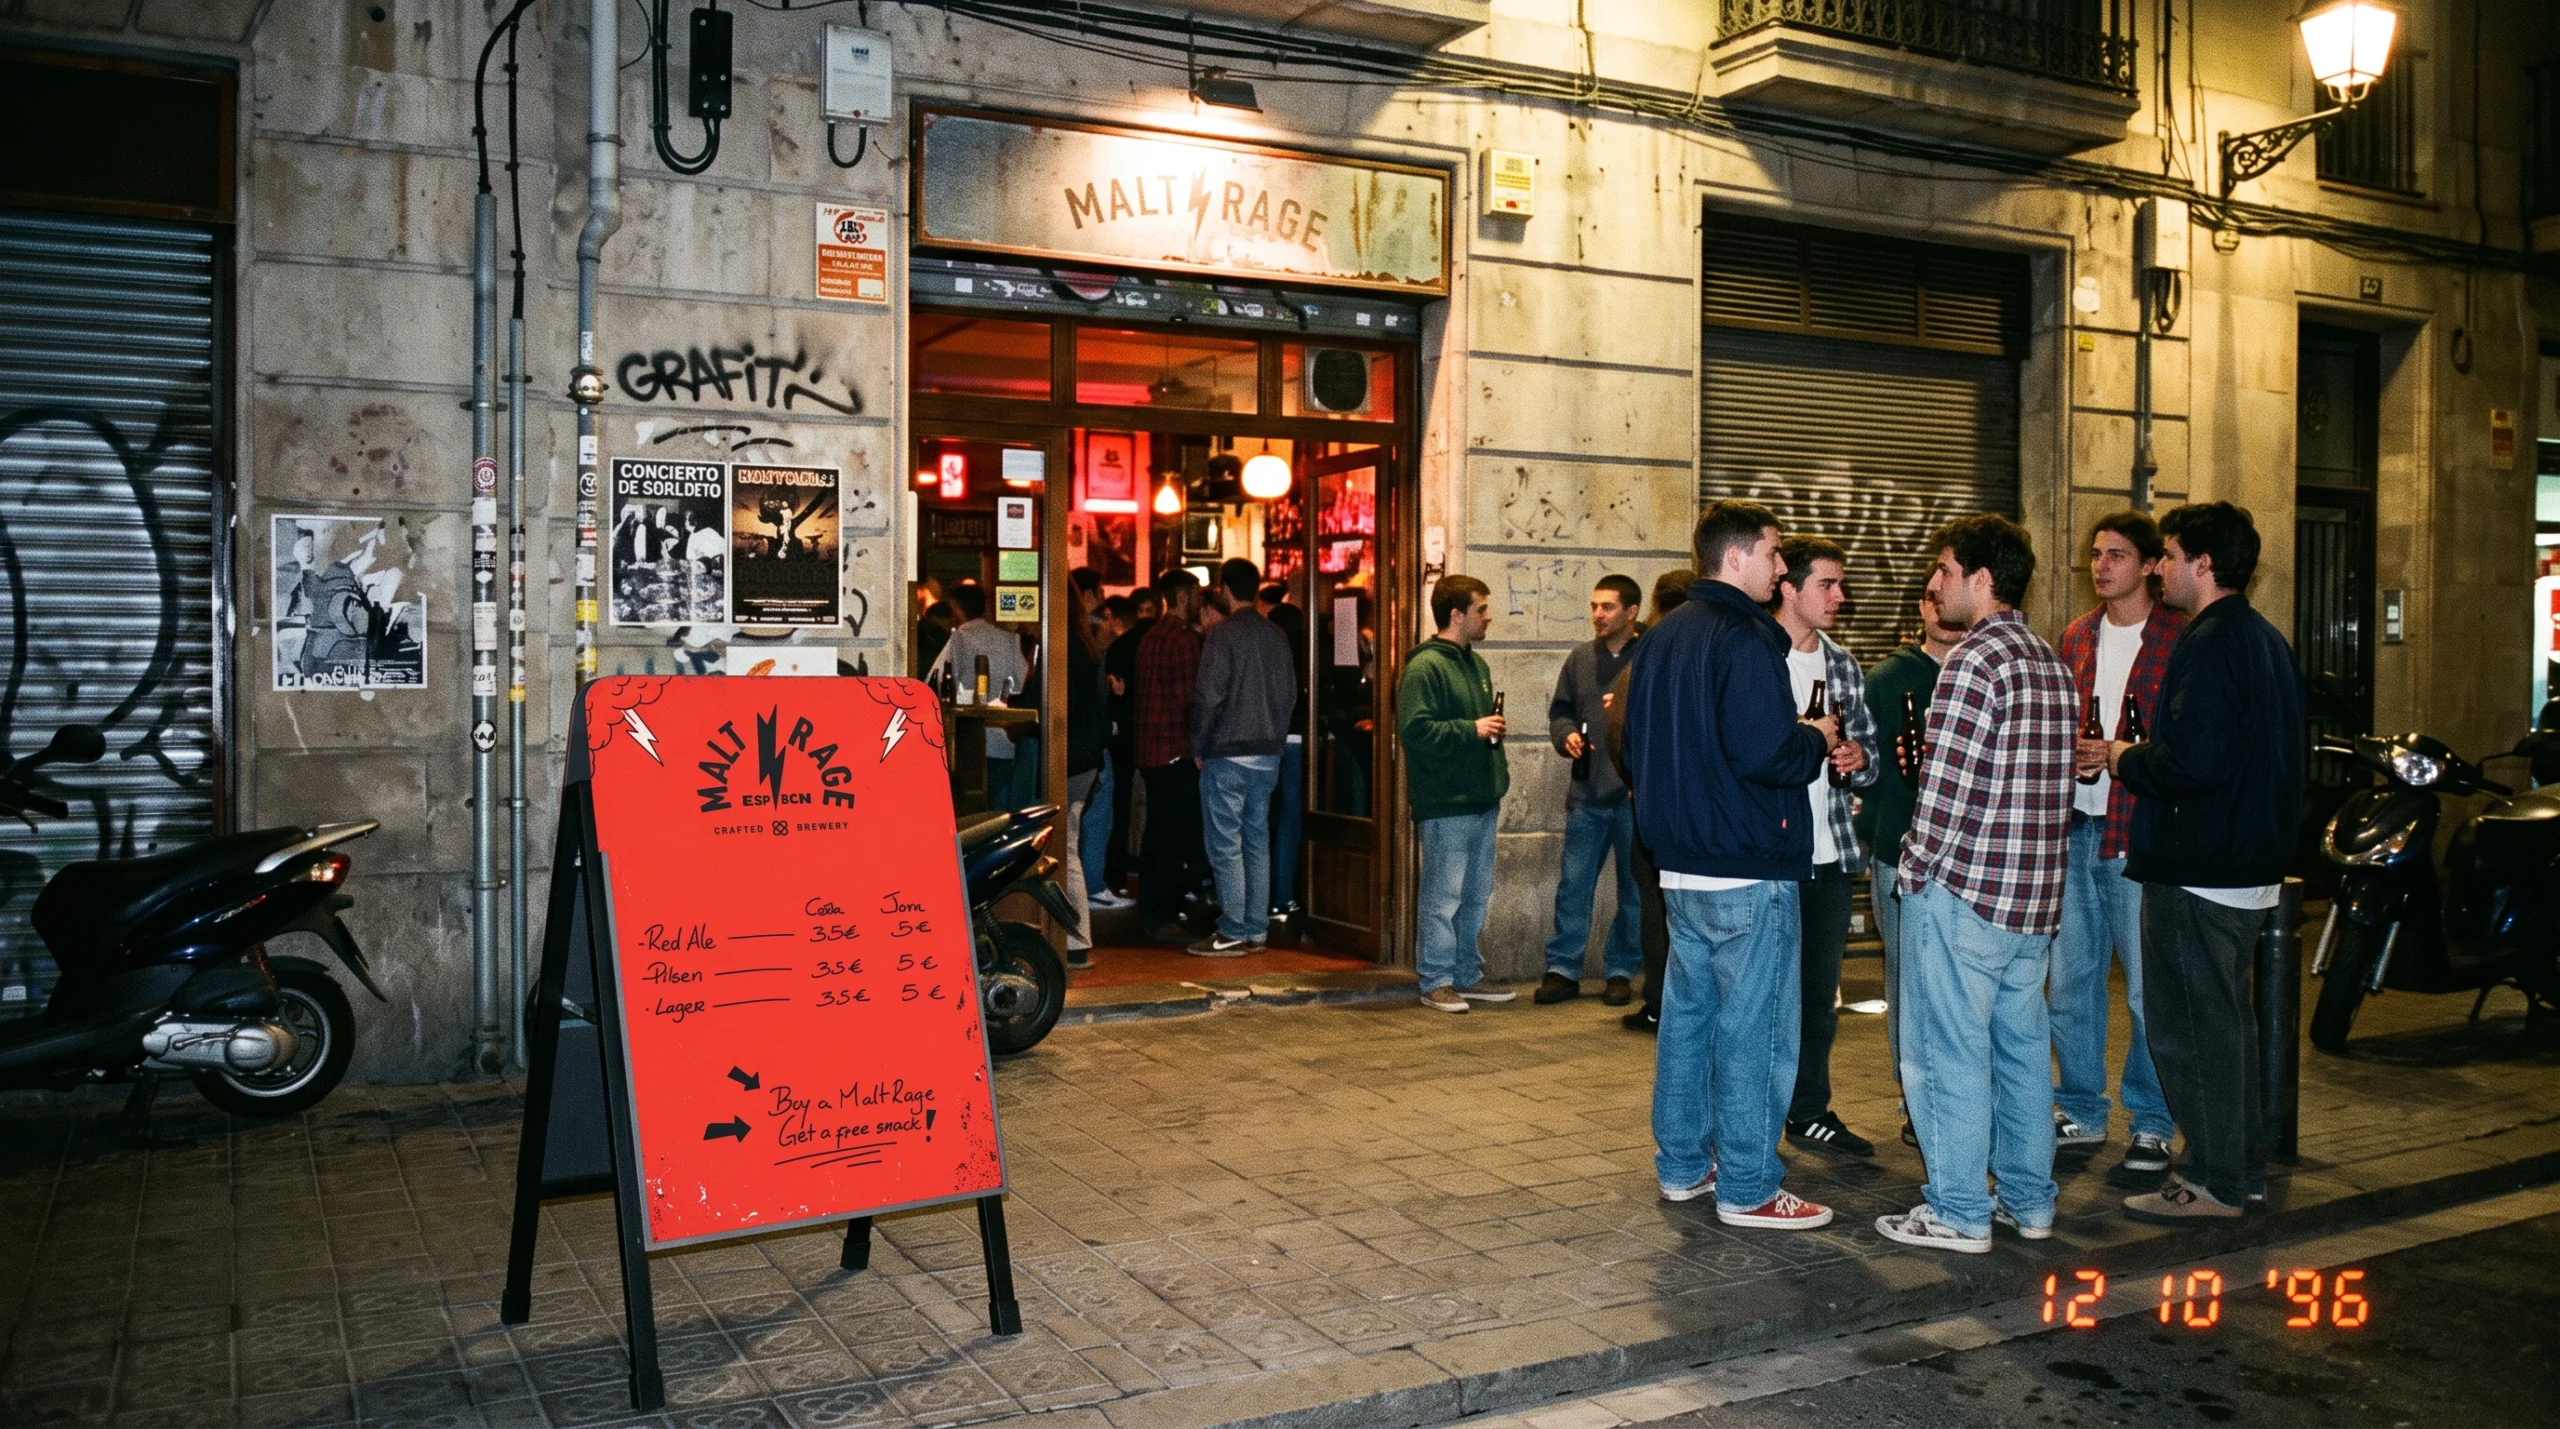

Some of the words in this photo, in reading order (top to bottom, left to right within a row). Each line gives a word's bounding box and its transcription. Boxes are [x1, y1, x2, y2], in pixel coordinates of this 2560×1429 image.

[1064, 175, 1178, 230] MALT
[1221, 180, 1328, 252] RAGE
[620, 463, 719, 482] CONCIERTO
[619, 480, 639, 495] DE
[642, 480, 722, 498] SORLDETO
[696, 720, 746, 813] MALT
[788, 716, 855, 810] RAGE
[742, 794, 771, 807] ESP
[781, 792, 812, 805] BCN
[713, 825, 764, 835] CRAFTED
[796, 821, 849, 832] BREWERY
[686, 923, 716, 951] Ale
[818, 1100, 832, 1109] a
[779, 1115, 816, 1147] Get
[820, 1129, 831, 1139] a
[836, 1125, 871, 1149] free
